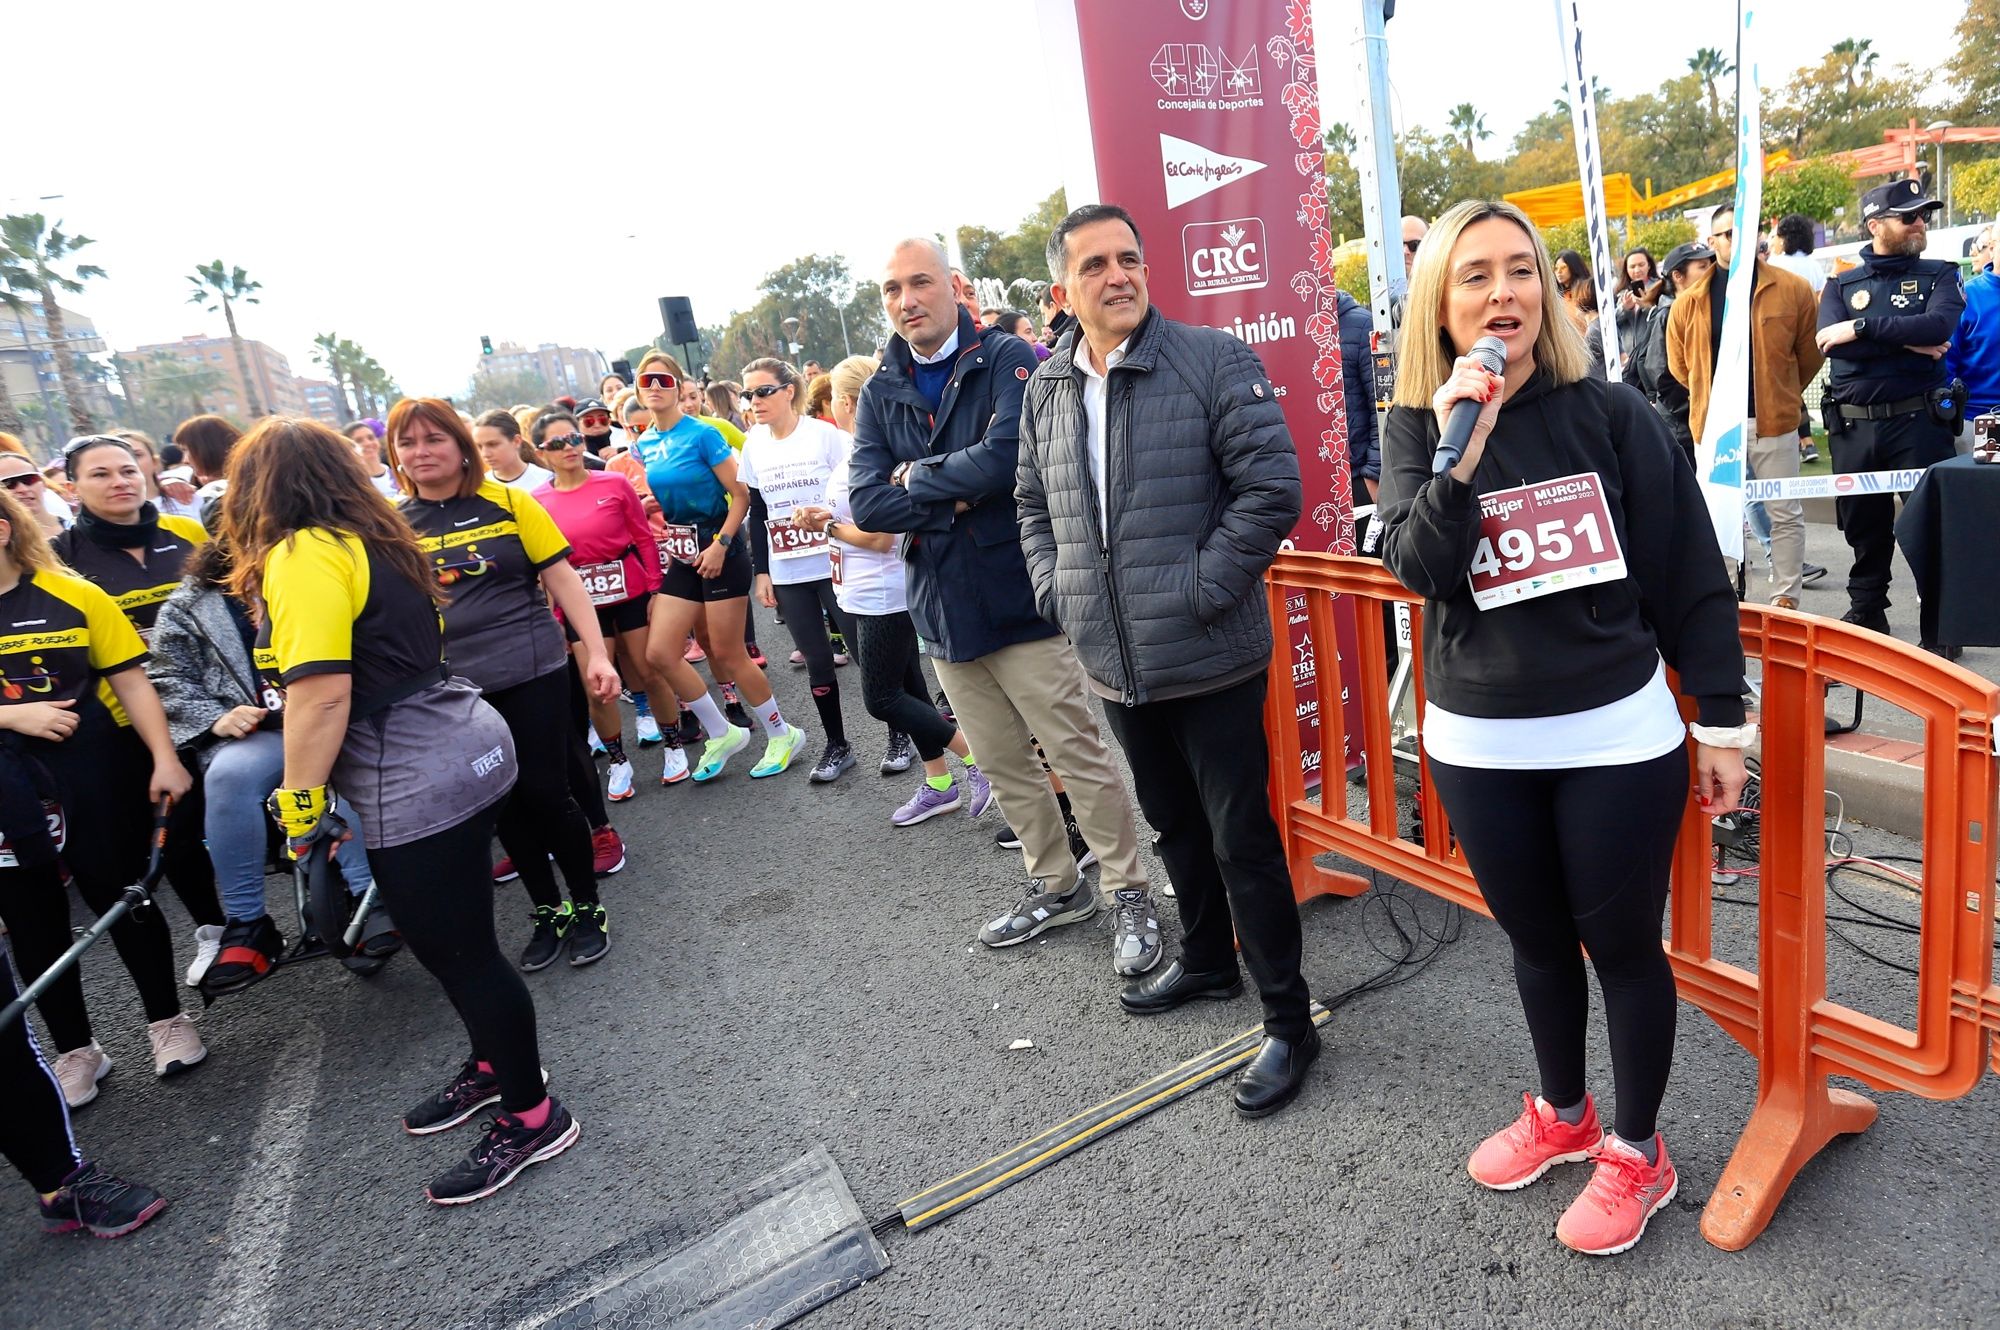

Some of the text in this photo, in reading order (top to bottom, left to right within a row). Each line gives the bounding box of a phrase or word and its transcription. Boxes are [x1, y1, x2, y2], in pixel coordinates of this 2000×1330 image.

[1207, 99, 1217, 110] de
[1218, 97, 1265, 111] Deportes
[1166, 157, 1243, 182] El Corte Inglés
[1191, 242, 1260, 278] CRC
[1207, 277, 1230, 287] RURAL
[1230, 273, 1261, 284] CENTRAL
[1201, 311, 1296, 345] inión
[764, 477, 820, 494] COMPAÑERAS
[1534, 479, 1593, 501] MURCIA
[1553, 494, 1578, 504] MARZO
[1578, 490, 1596, 499] 2023
[667, 538, 697, 555] 218
[1470, 512, 1605, 578] 4951
[584, 573, 623, 593] 482
